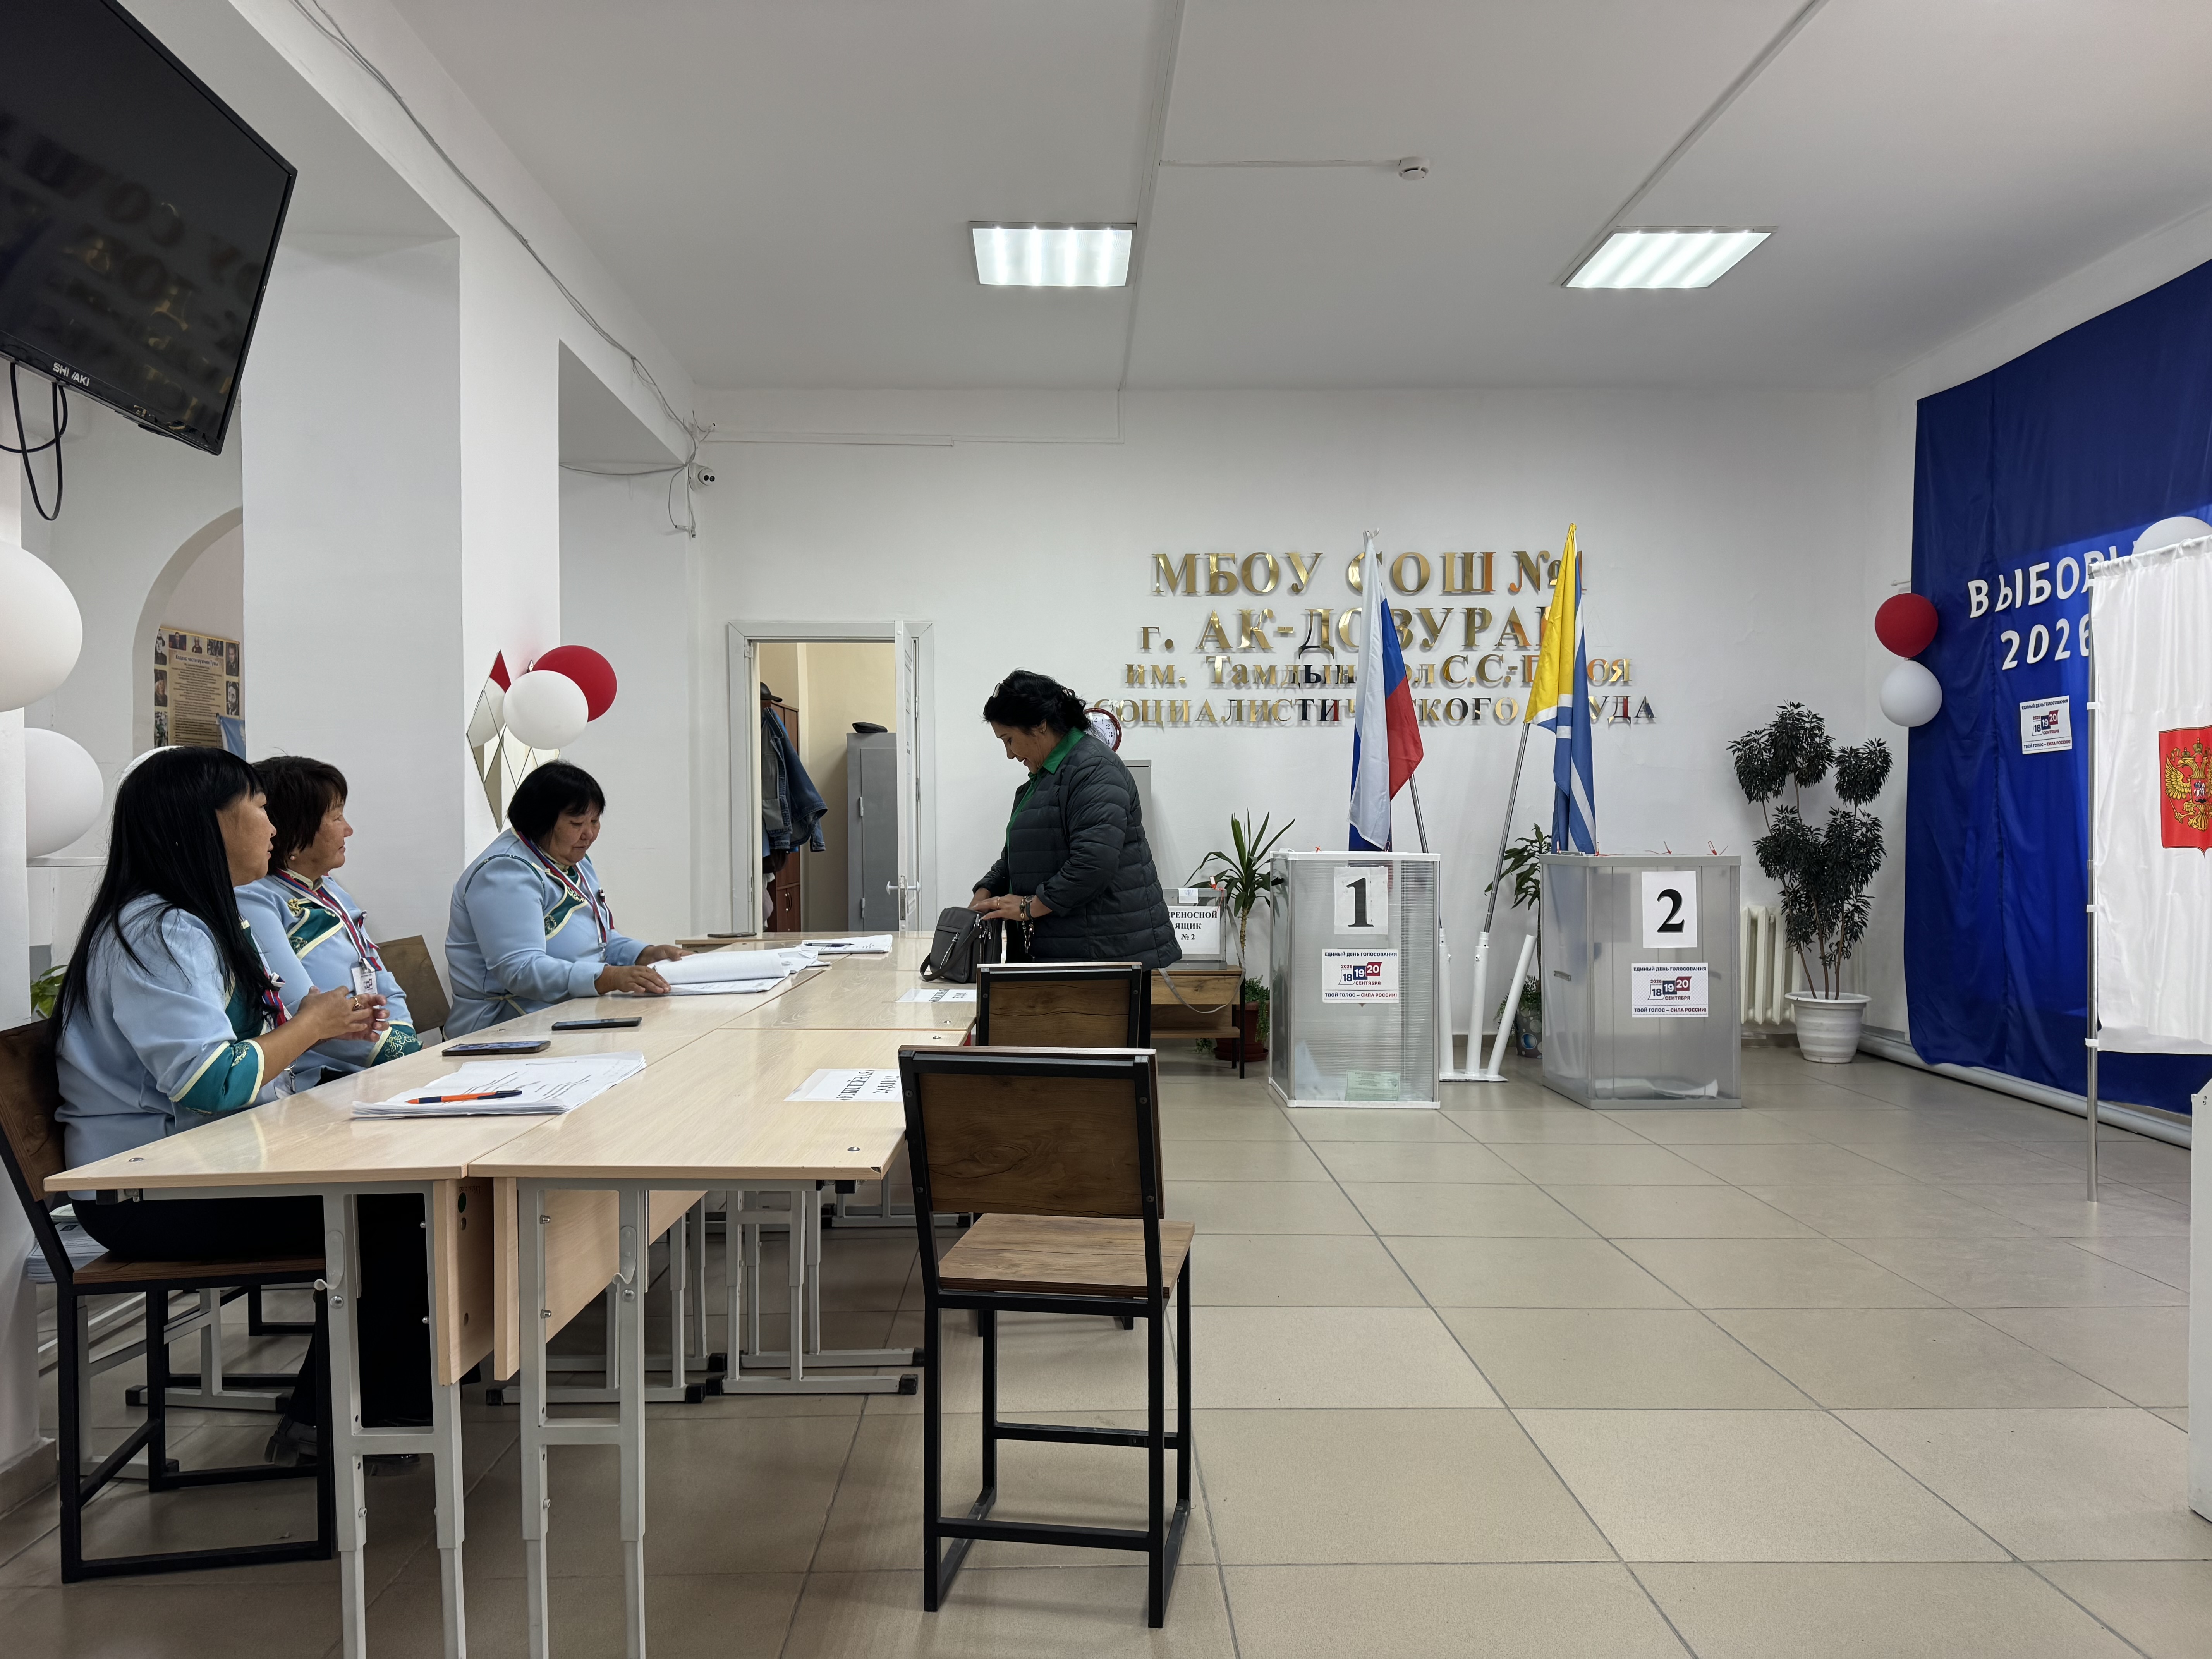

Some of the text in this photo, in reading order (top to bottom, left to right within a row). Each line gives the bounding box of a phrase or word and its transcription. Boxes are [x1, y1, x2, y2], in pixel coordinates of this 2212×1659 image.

[1151, 552, 1323, 594] МБОУ
[1348, 551, 1496, 593] СОШ
[1968, 541, 2136, 618] ВЫБОР
[1140, 627, 1174, 649] г.
[1125, 664, 1187, 684] им.
[2034, 713, 2057, 732] 18 19 20
[1346, 877, 1374, 927] 1
[1657, 888, 1685, 933] 2
[1343, 965, 1379, 982] 18 19 20
[1664, 984, 1674, 992] 19
[1676, 980, 1689, 988] 20
